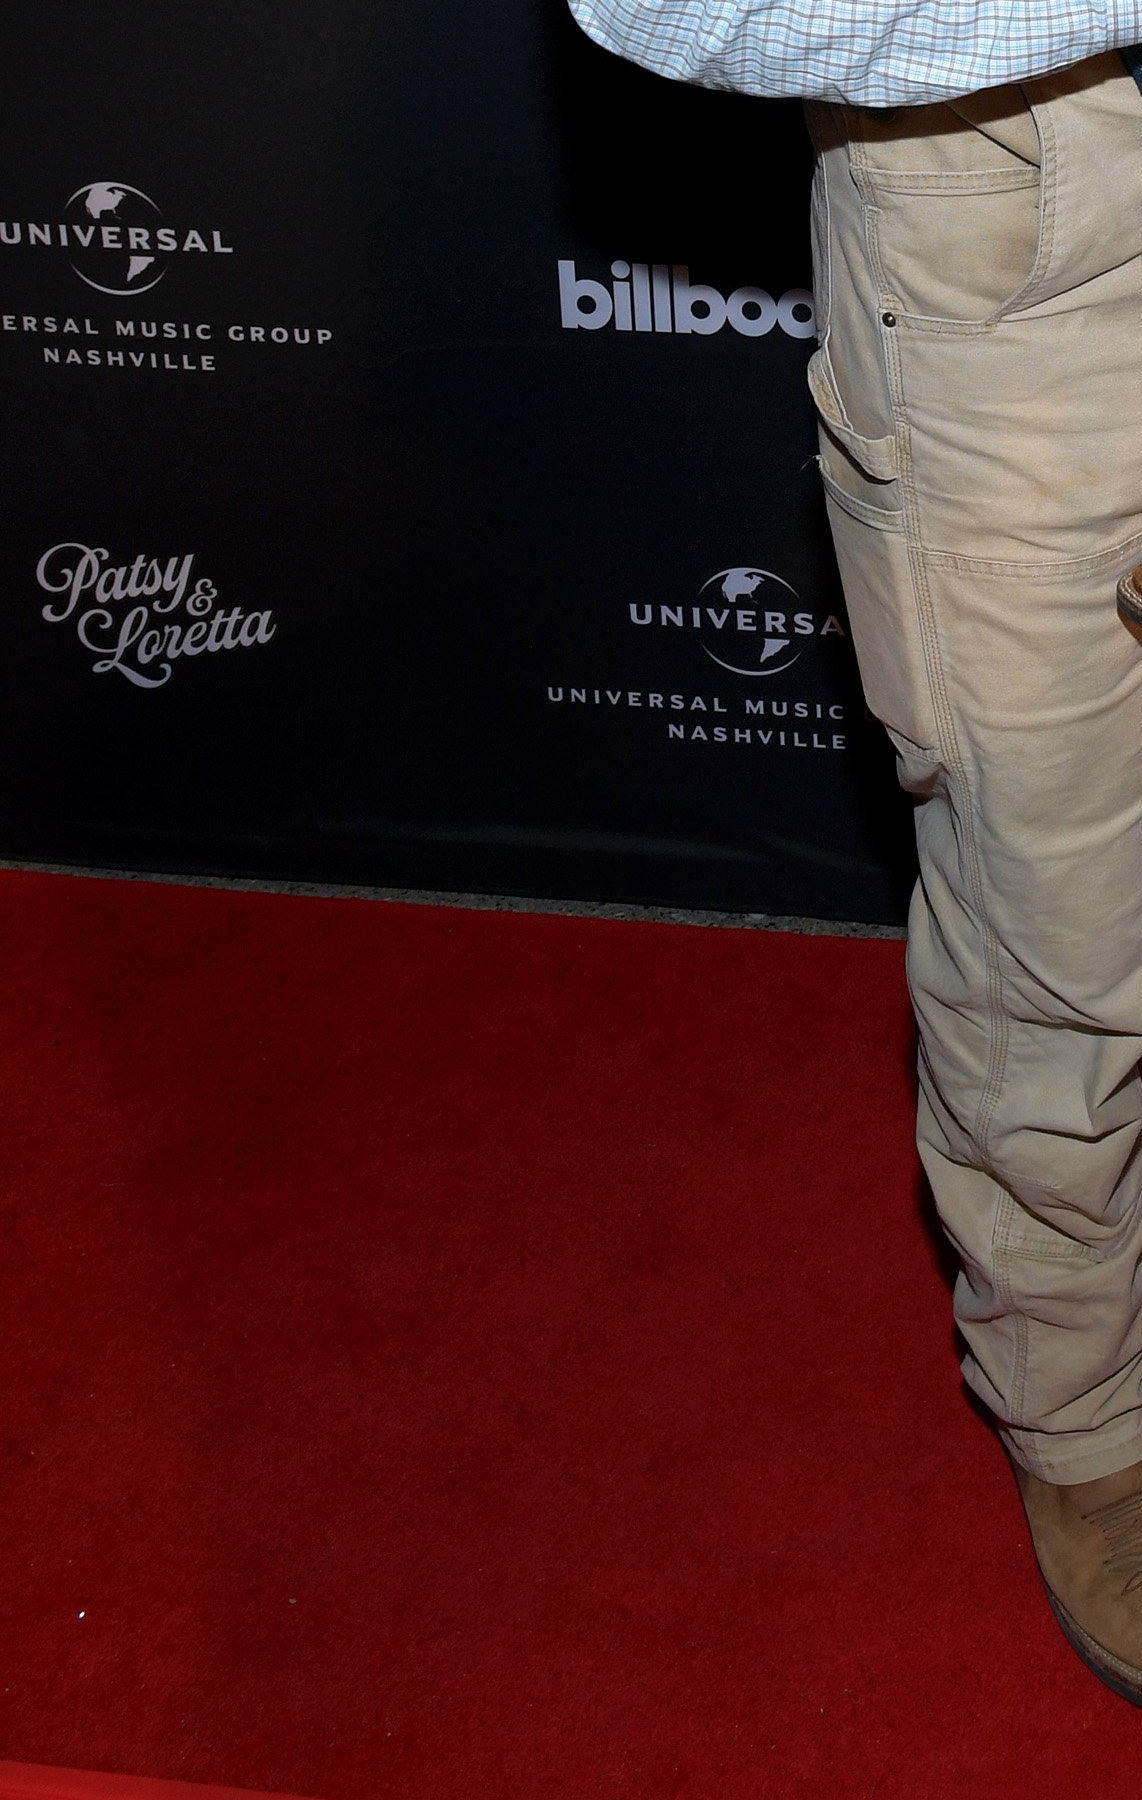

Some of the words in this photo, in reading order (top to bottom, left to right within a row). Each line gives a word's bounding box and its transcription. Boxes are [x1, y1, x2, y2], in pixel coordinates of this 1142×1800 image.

[0, 222, 234, 254] UNIVERSAL
[2, 315, 99, 335] ERSAL
[115, 320, 212, 340] MUSIC
[227, 325, 333, 345] GROUP
[43, 347, 216, 371] NASHVILLE
[36, 542, 194, 623] Patsy
[186, 578, 218, 616] &
[77, 606, 277, 689] Loretta
[547, 686, 728, 713] UNIVERSAL
[745, 699, 844, 720] MUSIC
[668, 723, 846, 750] NASHVILLE
